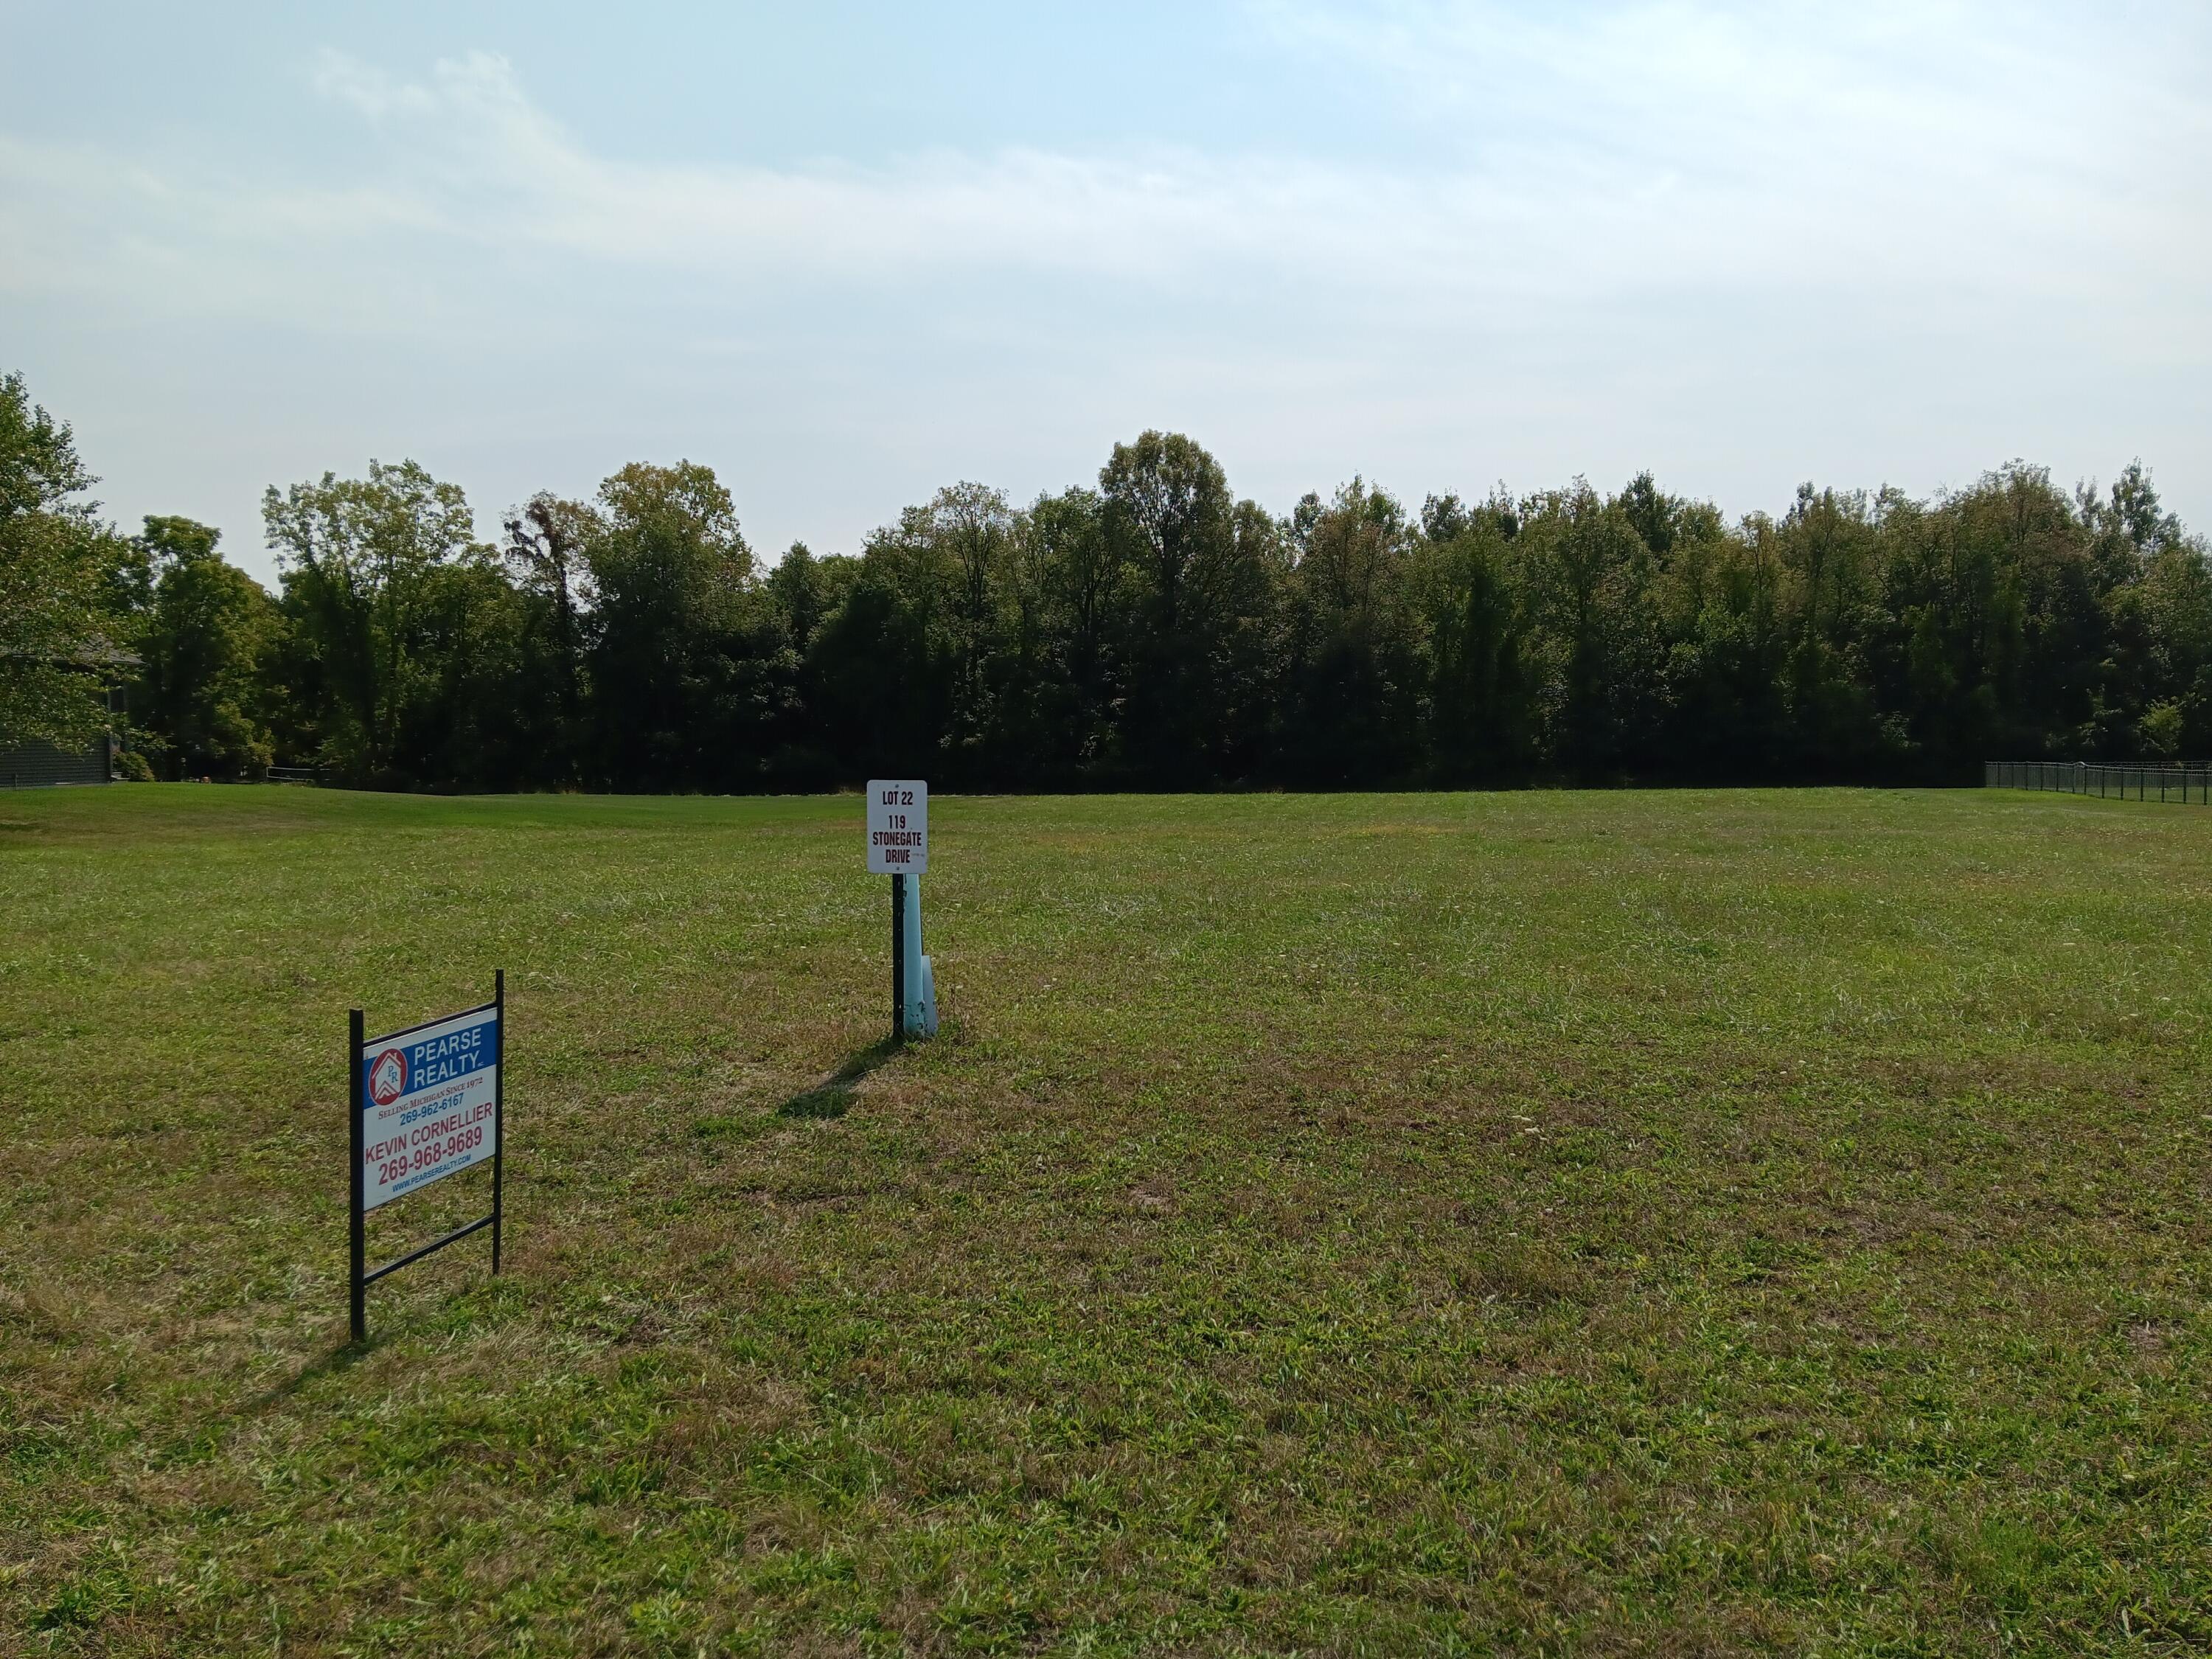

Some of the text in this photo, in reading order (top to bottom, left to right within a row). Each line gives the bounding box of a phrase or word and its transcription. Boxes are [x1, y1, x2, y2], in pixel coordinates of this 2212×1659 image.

[883, 791, 913, 805] LOT 22
[888, 815, 905, 829] 119
[872, 832, 922, 846] STONEGATE
[886, 849, 910, 863] DRIVE
[414, 1027, 481, 1065] PEARSE
[414, 1050, 480, 1088] REALTY
[466, 1077, 483, 1088] 1972
[400, 1093, 465, 1126] 269-962-6167
[365, 1102, 493, 1164] KEVIN CORNELLIER
[378, 1126, 482, 1186] 269-968-9689
[392, 1154, 471, 1192] WWW.PEARSEREALTY.COM
